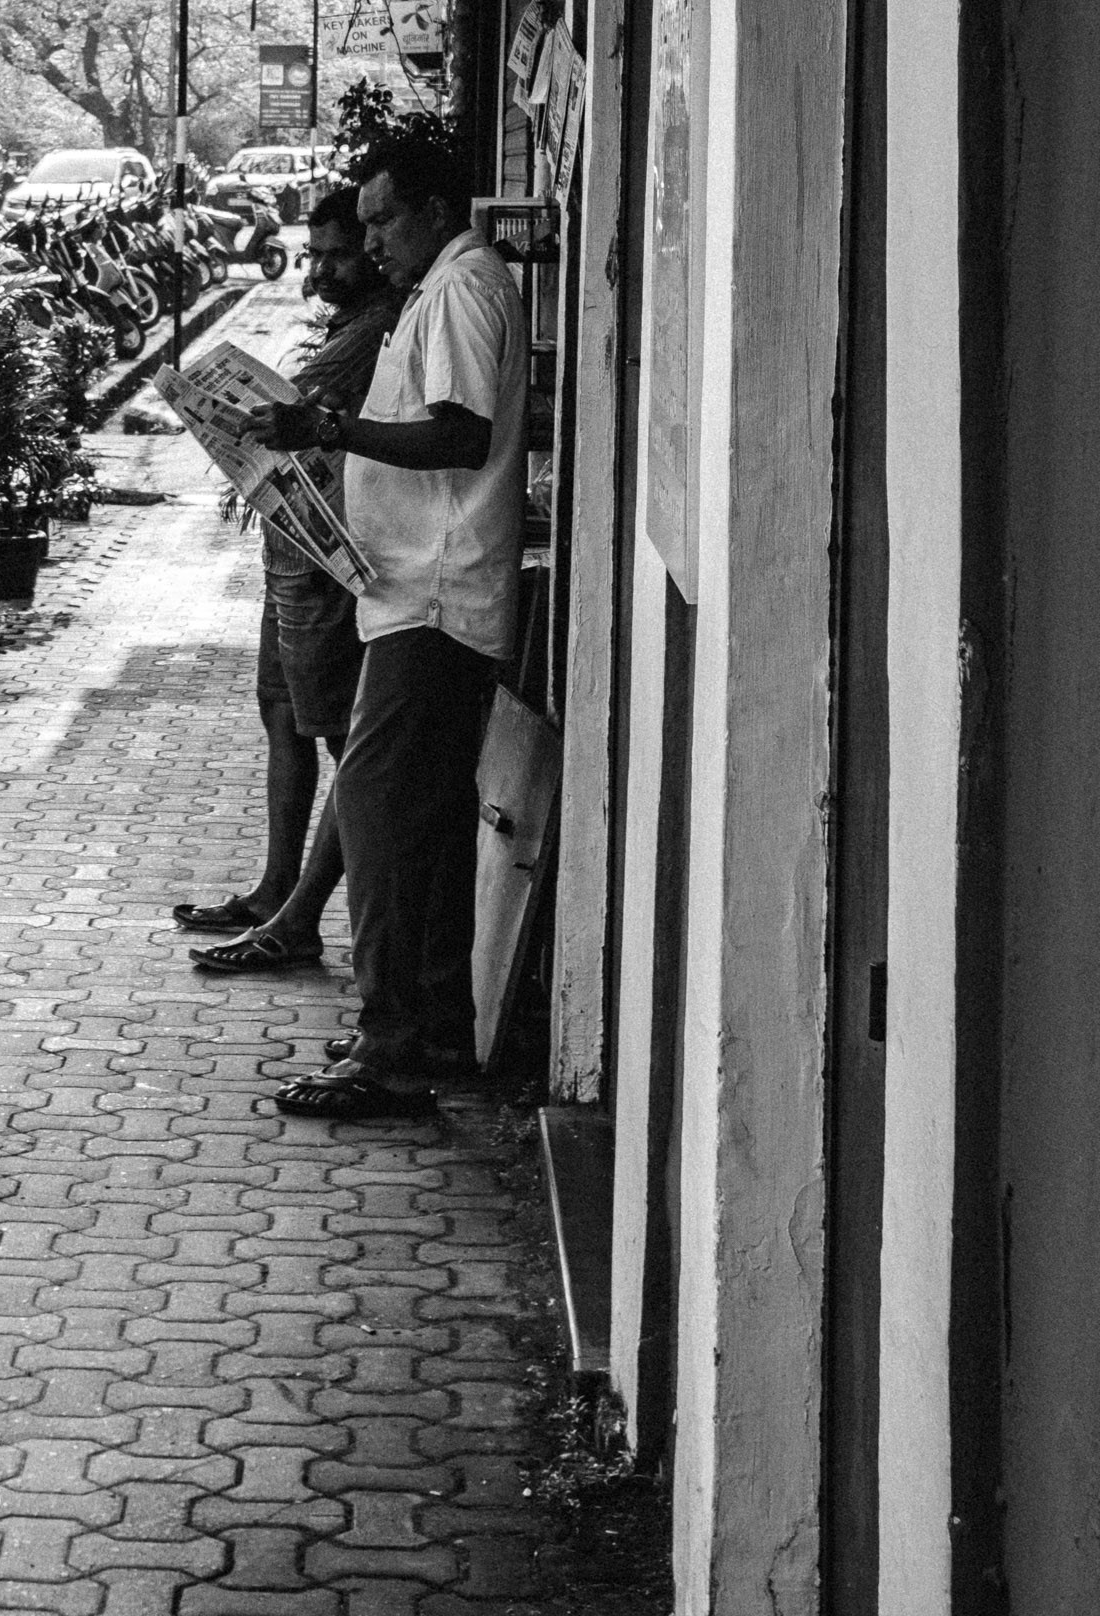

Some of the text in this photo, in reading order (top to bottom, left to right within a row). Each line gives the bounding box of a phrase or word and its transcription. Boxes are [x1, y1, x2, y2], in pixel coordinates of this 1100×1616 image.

[323, 16, 391, 31] KEY MAKERS
[351, 31, 368, 41] ON
[336, 42, 387, 55] MACHINE
